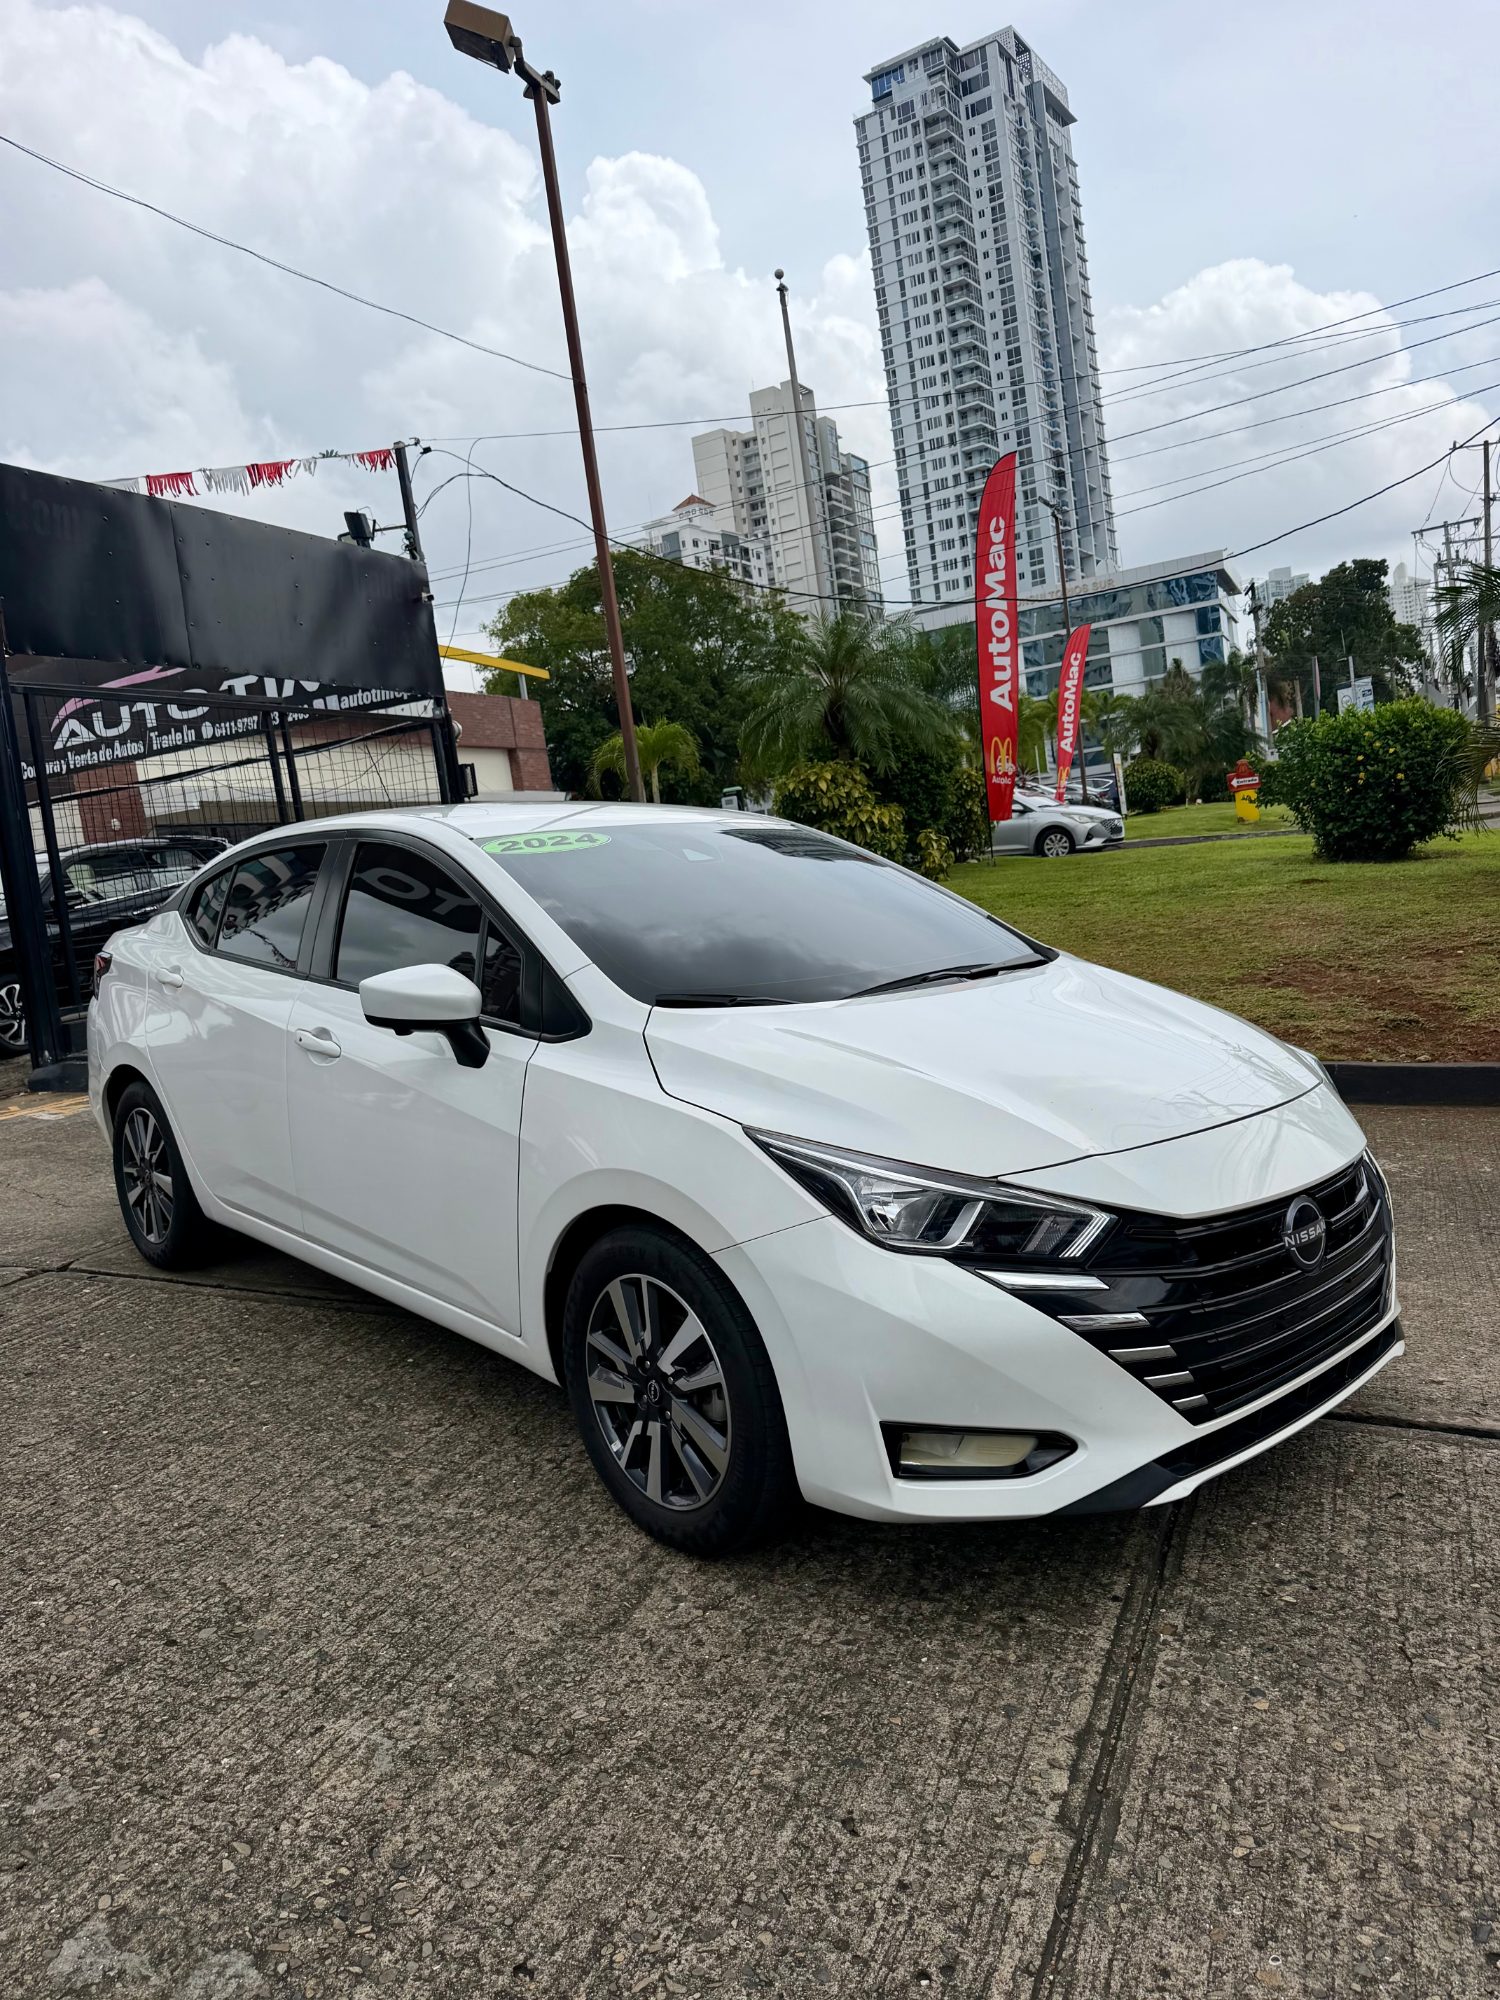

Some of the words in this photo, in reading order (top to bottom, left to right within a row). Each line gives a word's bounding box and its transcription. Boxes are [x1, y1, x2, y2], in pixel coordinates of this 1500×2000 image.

[985, 516, 1013, 712] AutoMac
[1060, 652, 1081, 753] AutoMac
[67, 749, 98, 769] Venta
[99, 744, 113, 761] de
[113, 740, 144, 759] Autos
[150, 728, 182, 750] Trade
[498, 833, 599, 852] 2024
[1284, 1219, 1326, 1248] NISSAN
